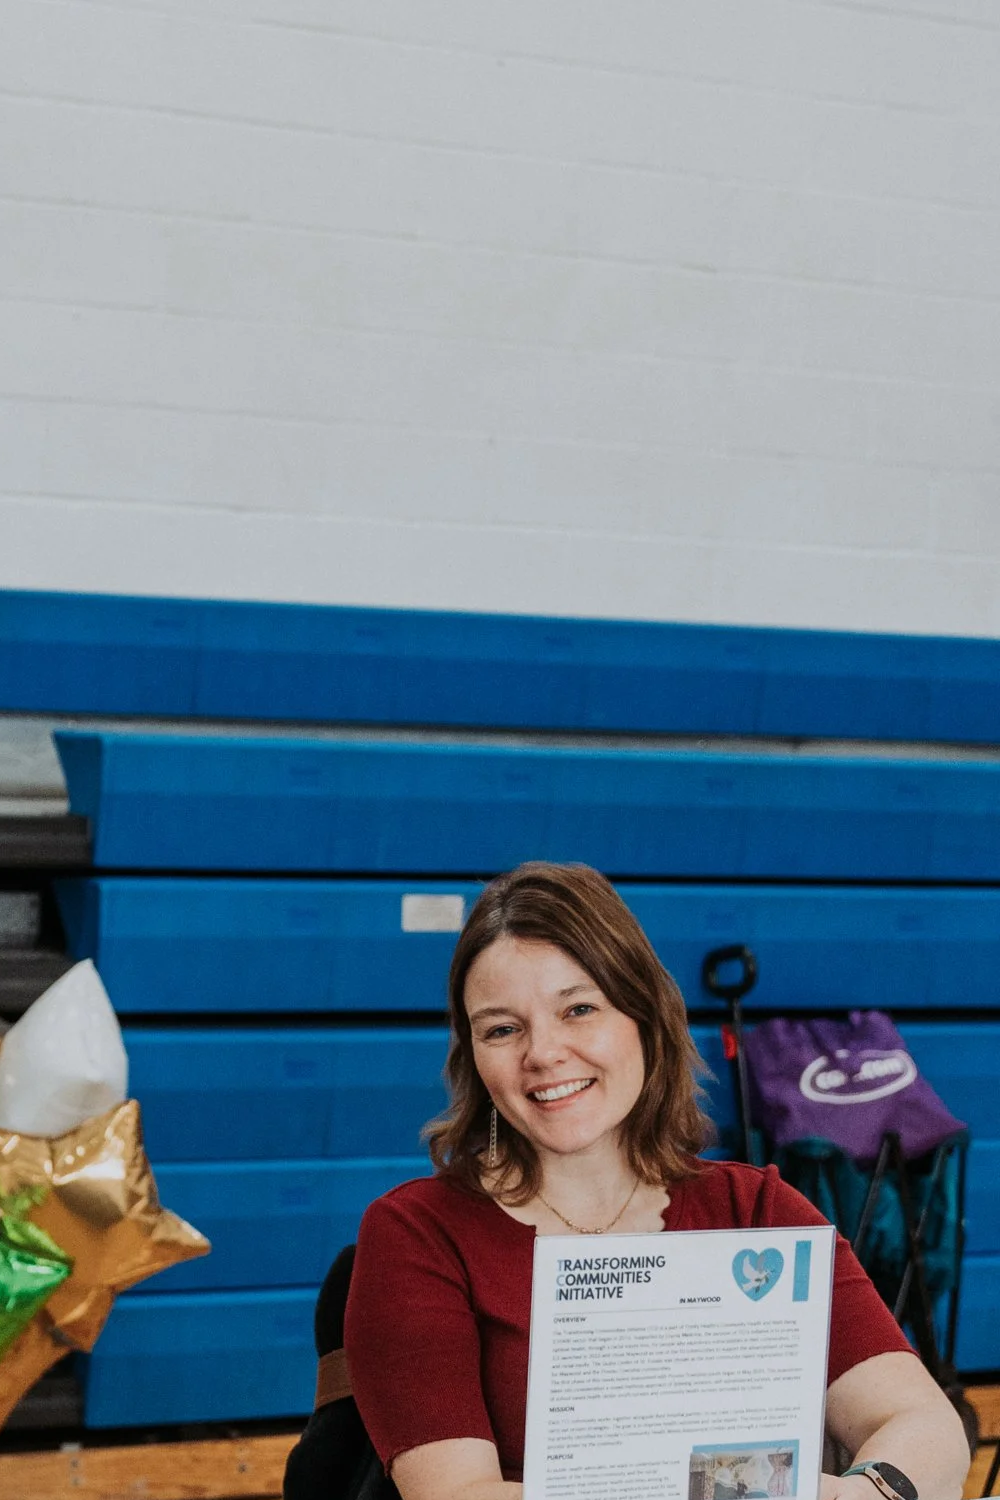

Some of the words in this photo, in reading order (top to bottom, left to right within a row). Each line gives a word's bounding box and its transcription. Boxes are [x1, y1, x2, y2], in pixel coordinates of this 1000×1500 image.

[557, 1255, 666, 1272] TRANSFORMING
[556, 1271, 652, 1287] COMMUNITIES
[555, 1286, 624, 1302] INITIATIVE
[687, 1296, 721, 1304] MAYWOOD
